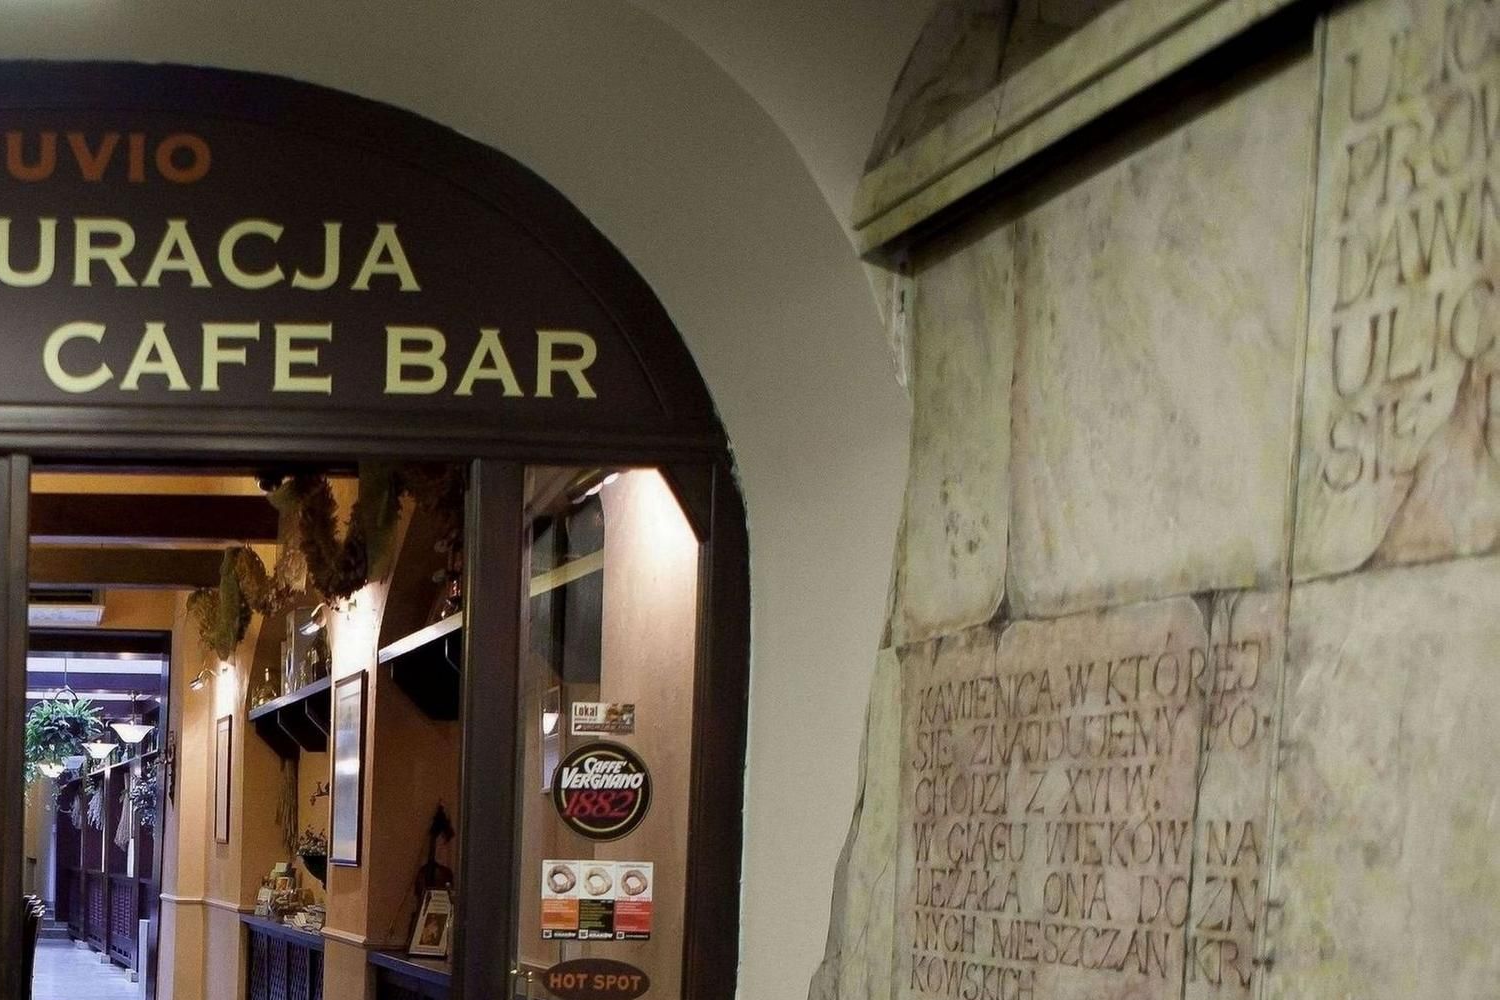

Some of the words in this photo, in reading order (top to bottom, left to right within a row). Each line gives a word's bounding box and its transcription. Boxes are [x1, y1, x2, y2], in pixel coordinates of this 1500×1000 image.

[43, 320, 333, 396] CAFE
[384, 324, 597, 399] BAR
[1067, 661, 1095, 707] W
[1105, 633, 1262, 703] KTÓREJ
[574, 704, 598, 717] Lokal
[912, 728, 954, 777] SIĘ
[969, 705, 1187, 765] ZNAJDUJEMY
[565, 790, 635, 818] 1882
[914, 770, 1009, 817] CHODZI
[1025, 771, 1045, 814] Z
[913, 822, 936, 863] W
[947, 821, 1028, 870] CIĄGU
[1045, 813, 1188, 866] WIEKÓW
[1206, 820, 1261, 866] NA
[1043, 873, 1110, 920] ONA
[1137, 876, 1190, 928] DO
[912, 911, 977, 955] NYCH
[549, 973, 588, 988] HOT
[593, 974, 641, 990] SPOT
